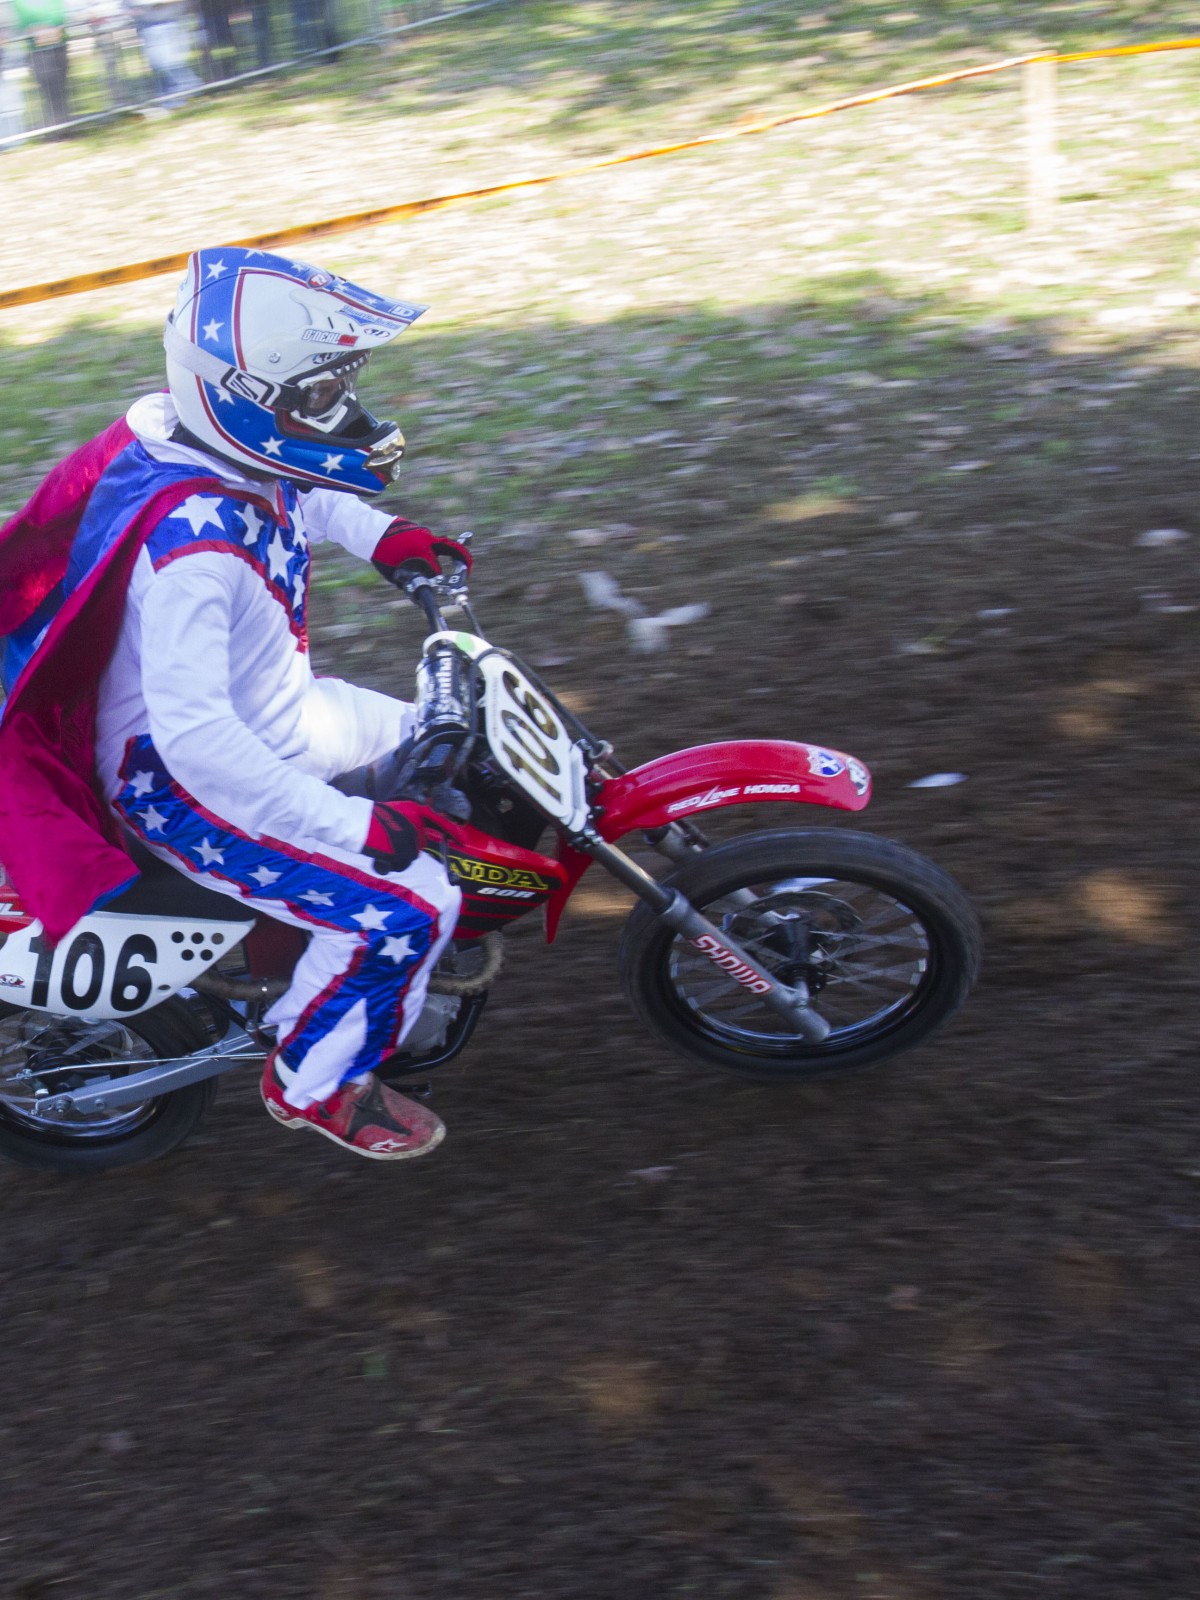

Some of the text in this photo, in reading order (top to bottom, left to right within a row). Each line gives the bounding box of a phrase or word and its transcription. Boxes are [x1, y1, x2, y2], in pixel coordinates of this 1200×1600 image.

[302, 329, 340, 345] O'NEAL
[500, 670, 562, 804] 106
[743, 784, 801, 795] HONDA
[440, 852, 548, 890] NDA
[29, 931, 158, 1012] 106
[690, 934, 772, 995] SHOWA
